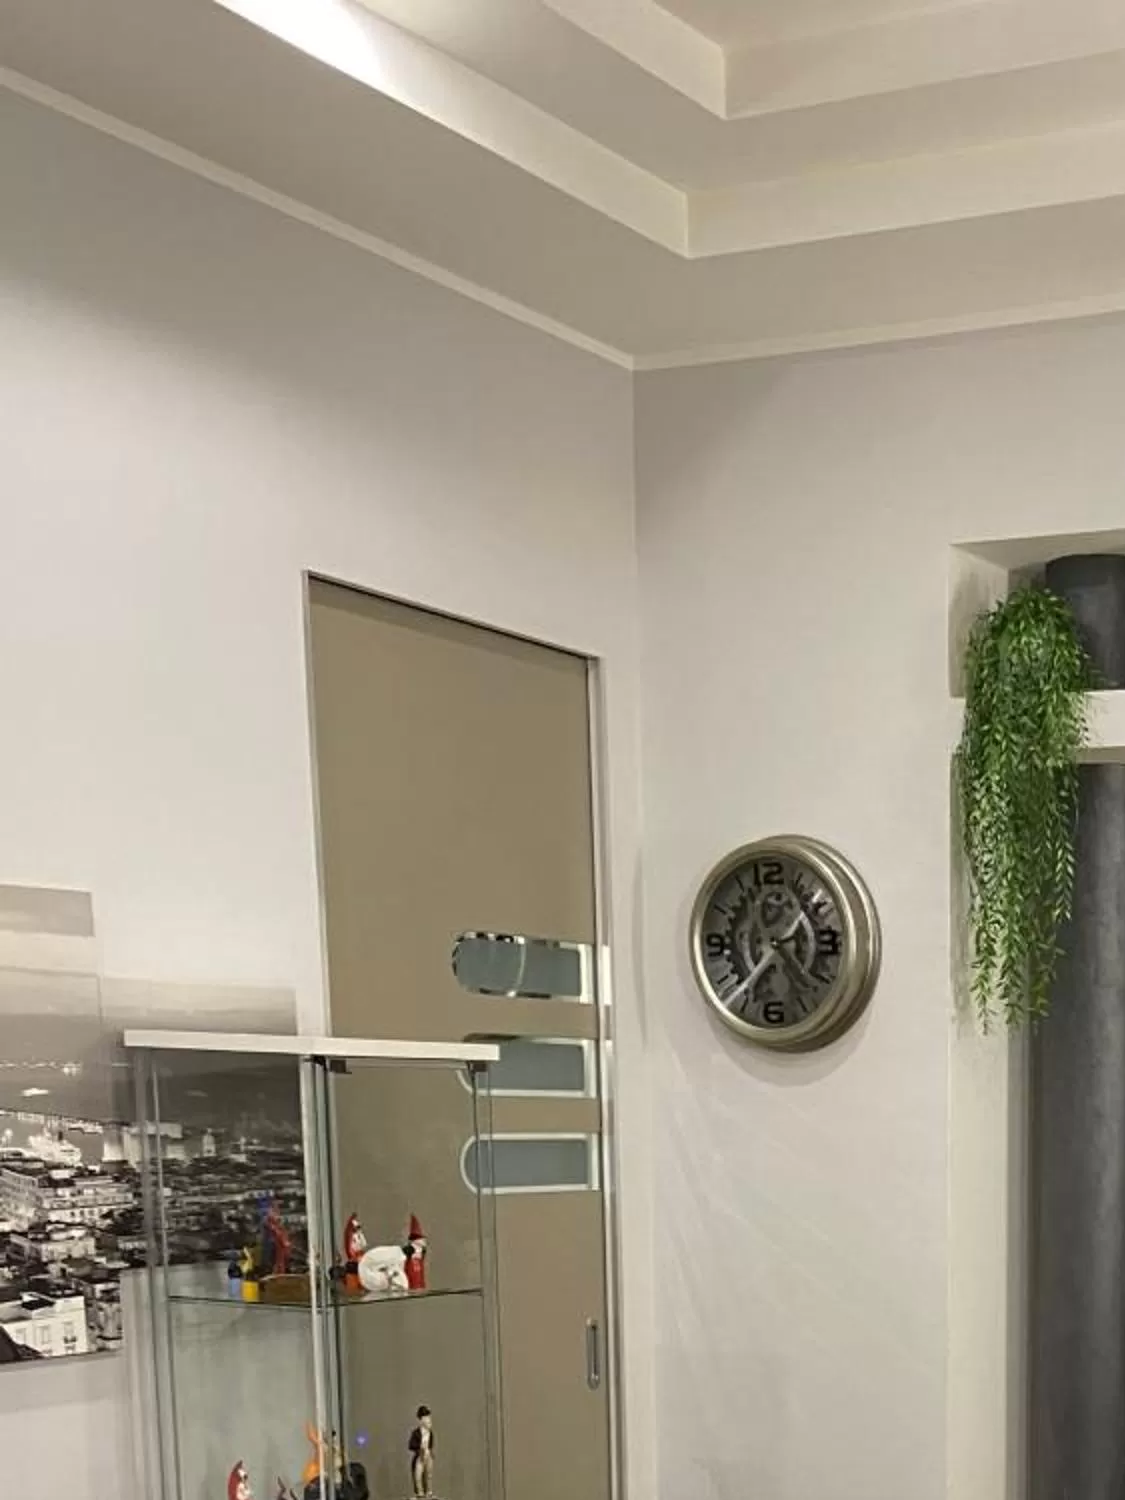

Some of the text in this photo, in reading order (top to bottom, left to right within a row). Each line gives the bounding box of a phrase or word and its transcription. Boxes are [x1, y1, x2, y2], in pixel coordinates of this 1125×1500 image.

[753, 863, 784, 886] 12
[706, 932, 725, 956] 9
[818, 929, 840, 956] 3
[763, 1001, 784, 1023] 6
